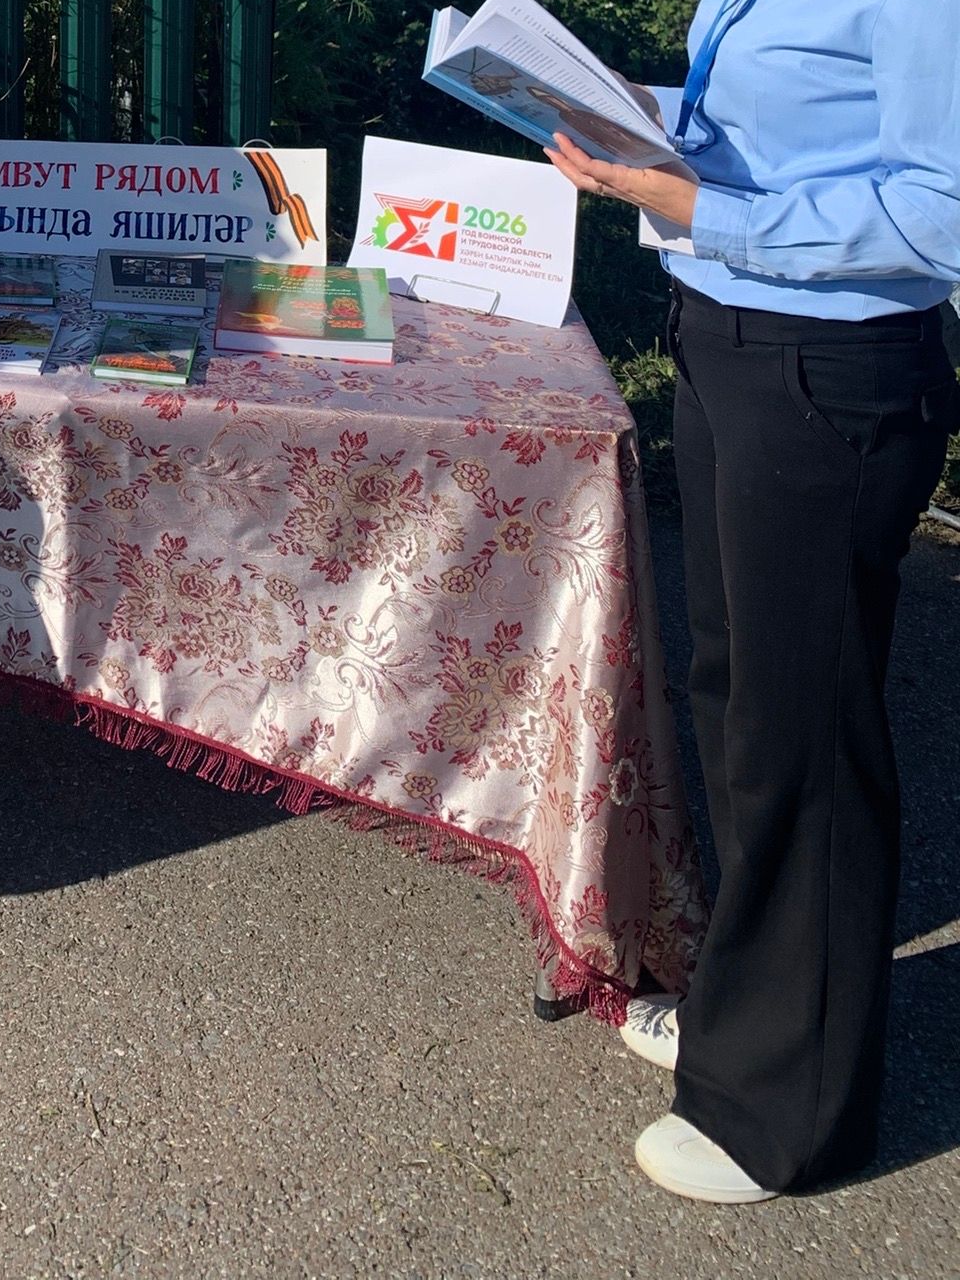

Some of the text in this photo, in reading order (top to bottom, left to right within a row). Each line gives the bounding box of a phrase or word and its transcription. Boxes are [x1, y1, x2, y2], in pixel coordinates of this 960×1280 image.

[463, 205, 528, 237] 2026
[461, 228, 522, 246] ГОД ВОИНСКОЙ
[468, 239, 510, 253] ТРУДОВОЙ
[510, 247, 552, 260] ДОБЛЕСТИ
